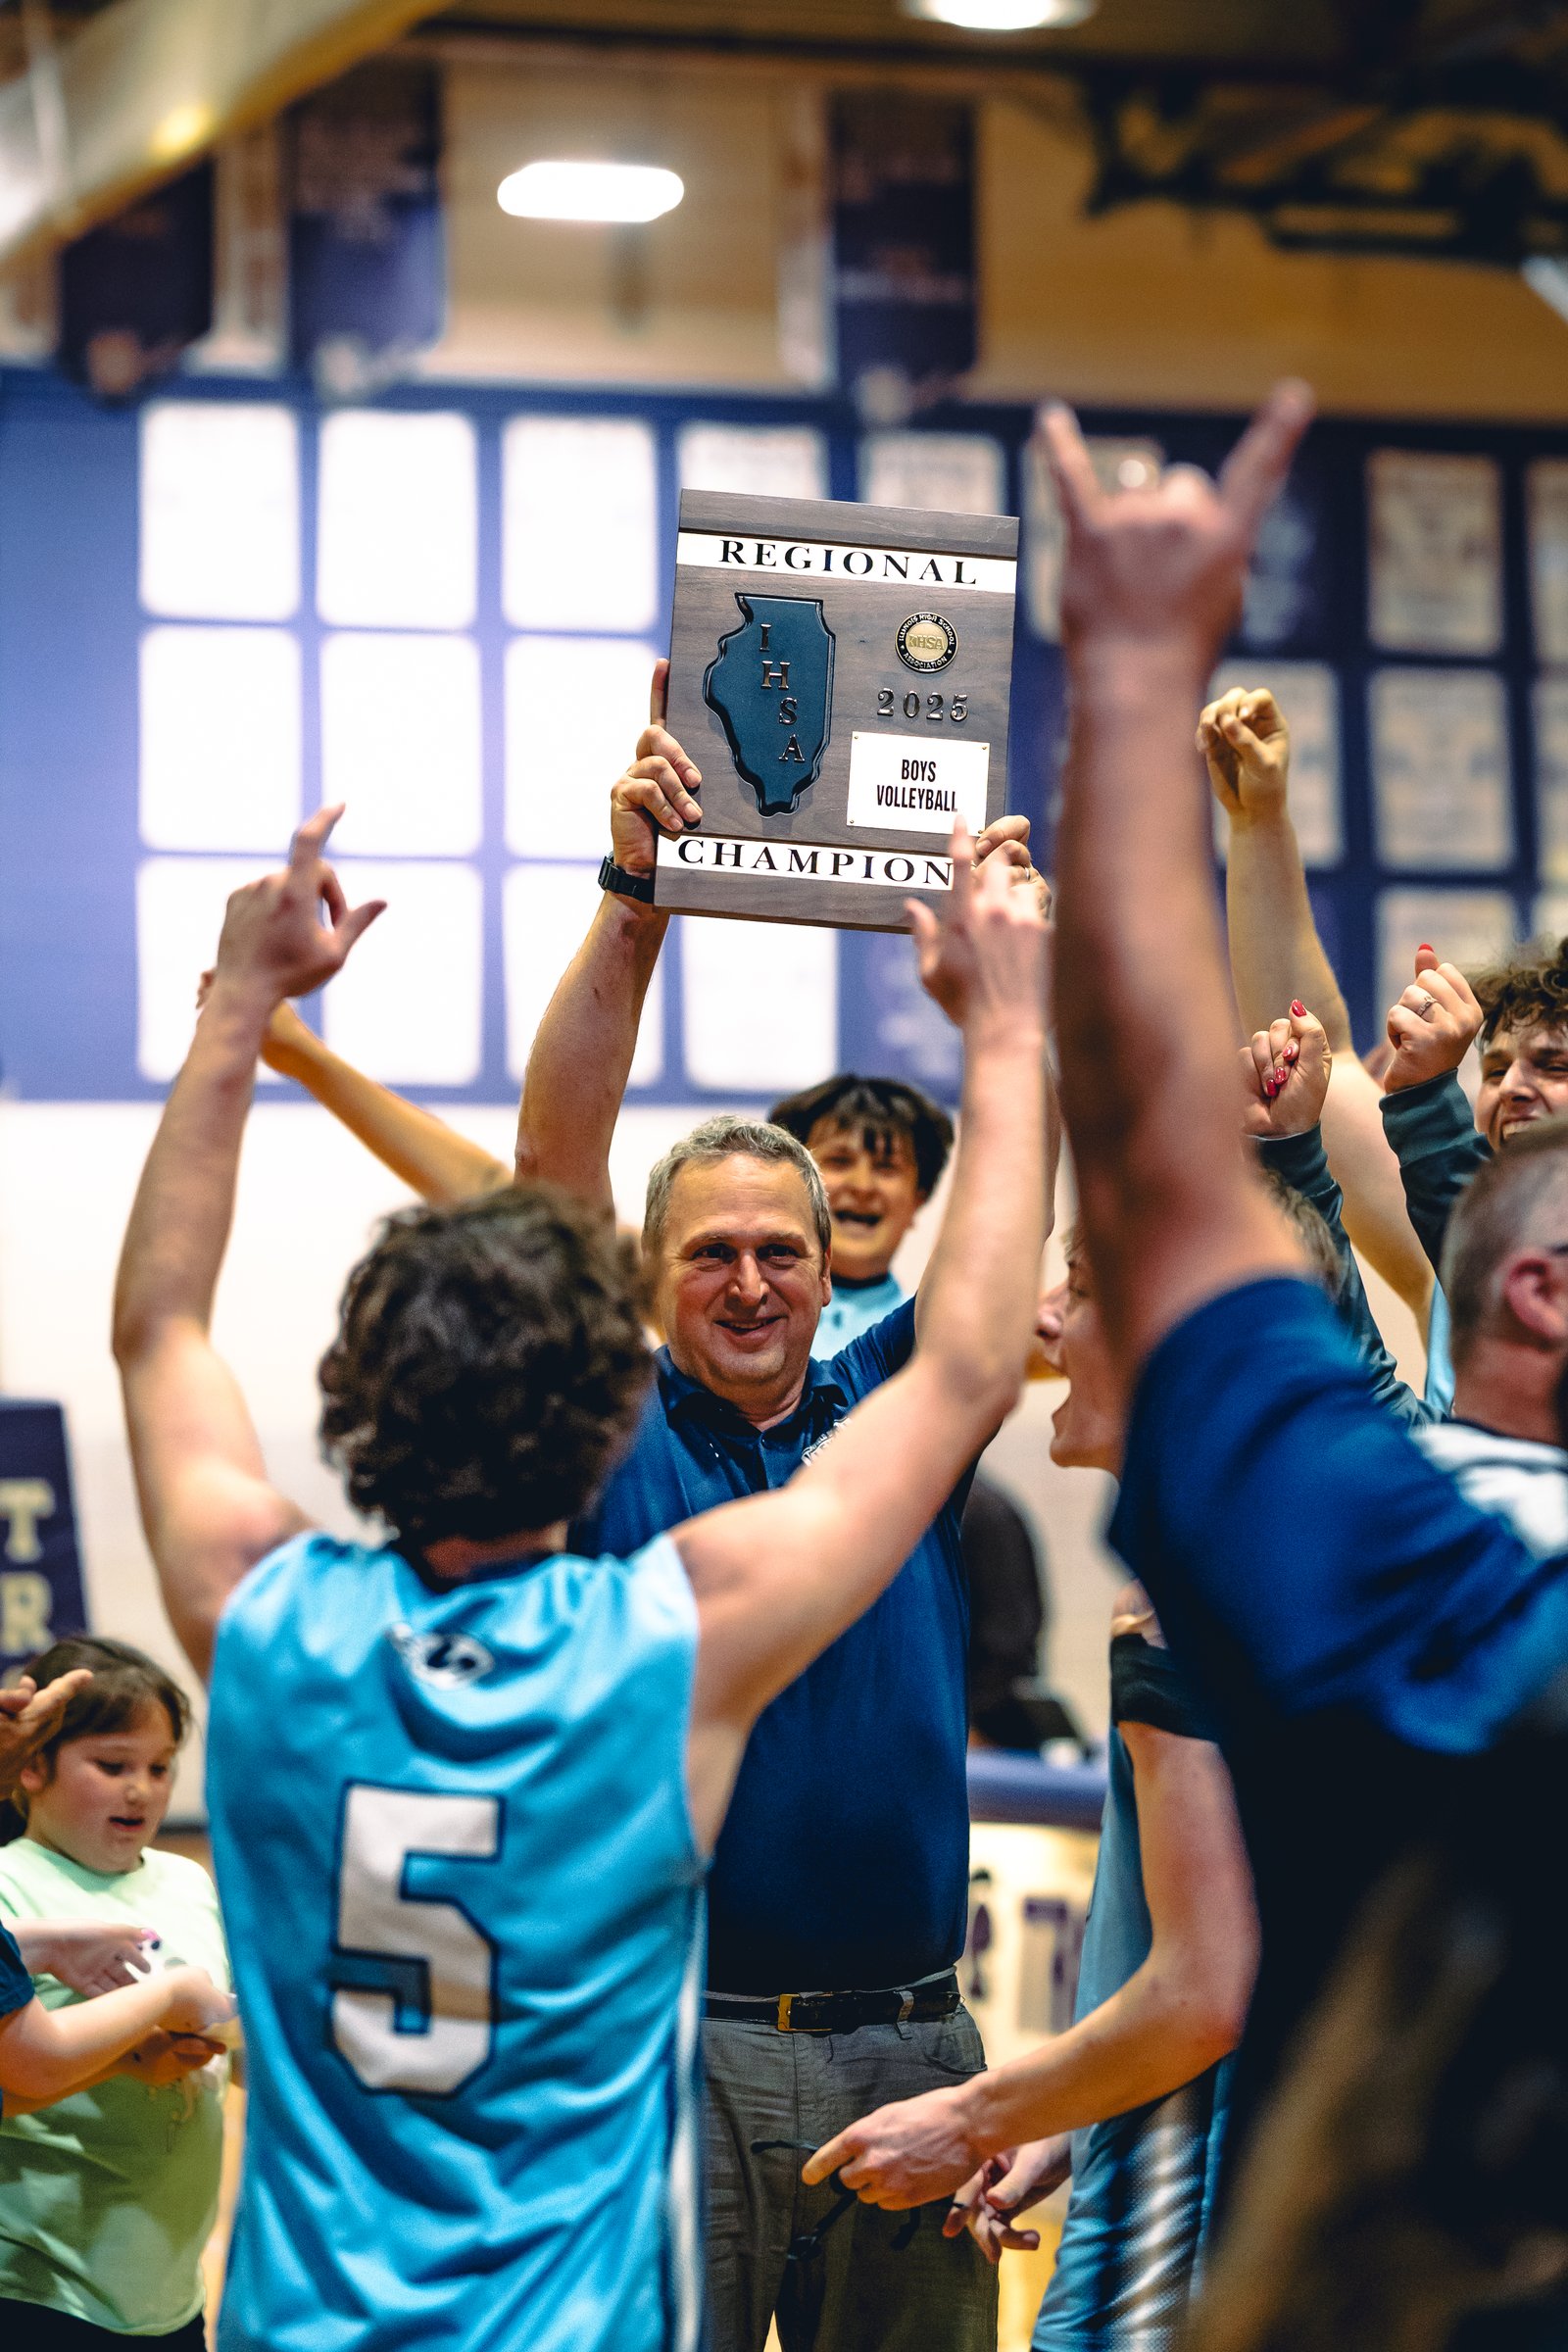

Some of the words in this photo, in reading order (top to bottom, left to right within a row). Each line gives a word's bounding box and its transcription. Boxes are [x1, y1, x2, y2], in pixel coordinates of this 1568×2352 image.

[718, 539, 977, 585] REGIONAL
[904, 653, 947, 668] ASSOCIATION
[760, 623, 806, 762] IHSA
[876, 687, 968, 722] 2025
[901, 759, 937, 782] BOYS
[876, 784, 958, 812] VOLLEYBALL
[677, 839, 970, 887] CHAMPION
[331, 1780, 504, 2096] 5
